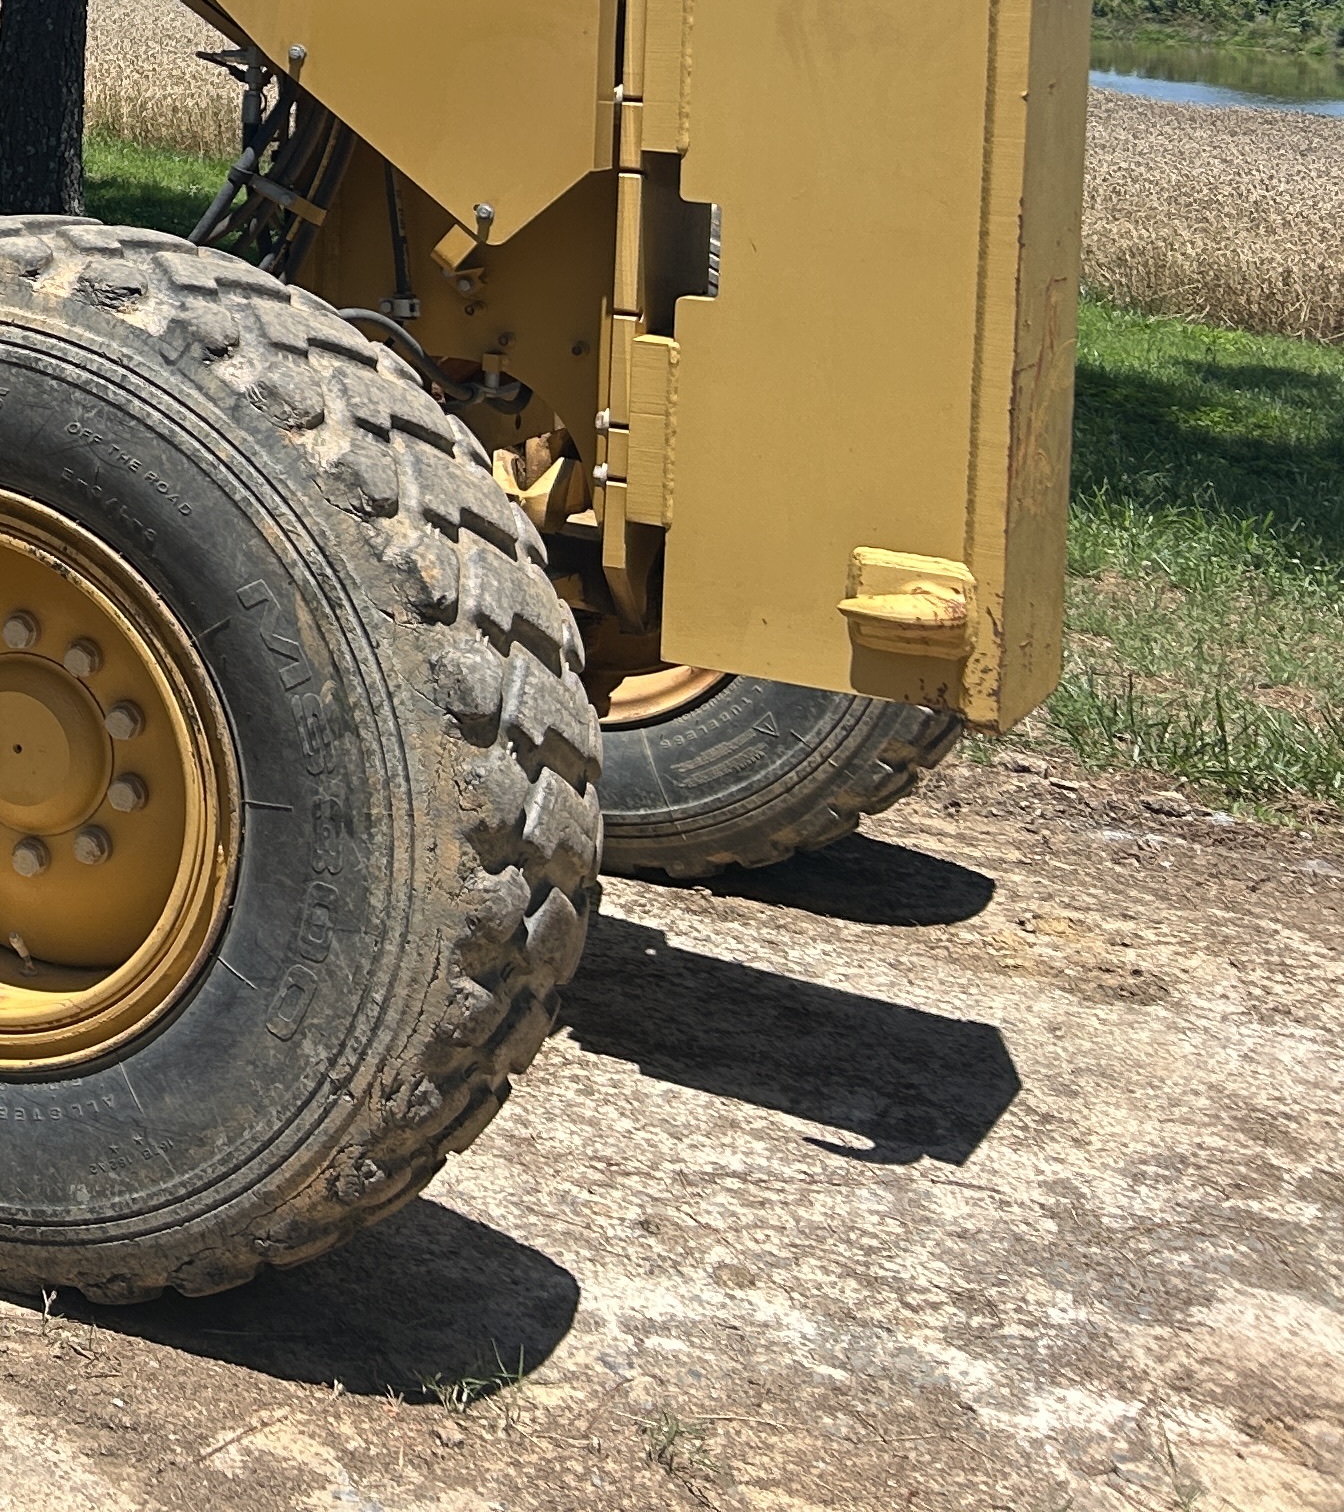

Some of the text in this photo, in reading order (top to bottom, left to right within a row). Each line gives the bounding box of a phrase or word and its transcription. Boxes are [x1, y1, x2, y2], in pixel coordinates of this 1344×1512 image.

[66, 421, 193, 516] OFF THE ROAD
[71, 1094, 115, 1117] ALL
